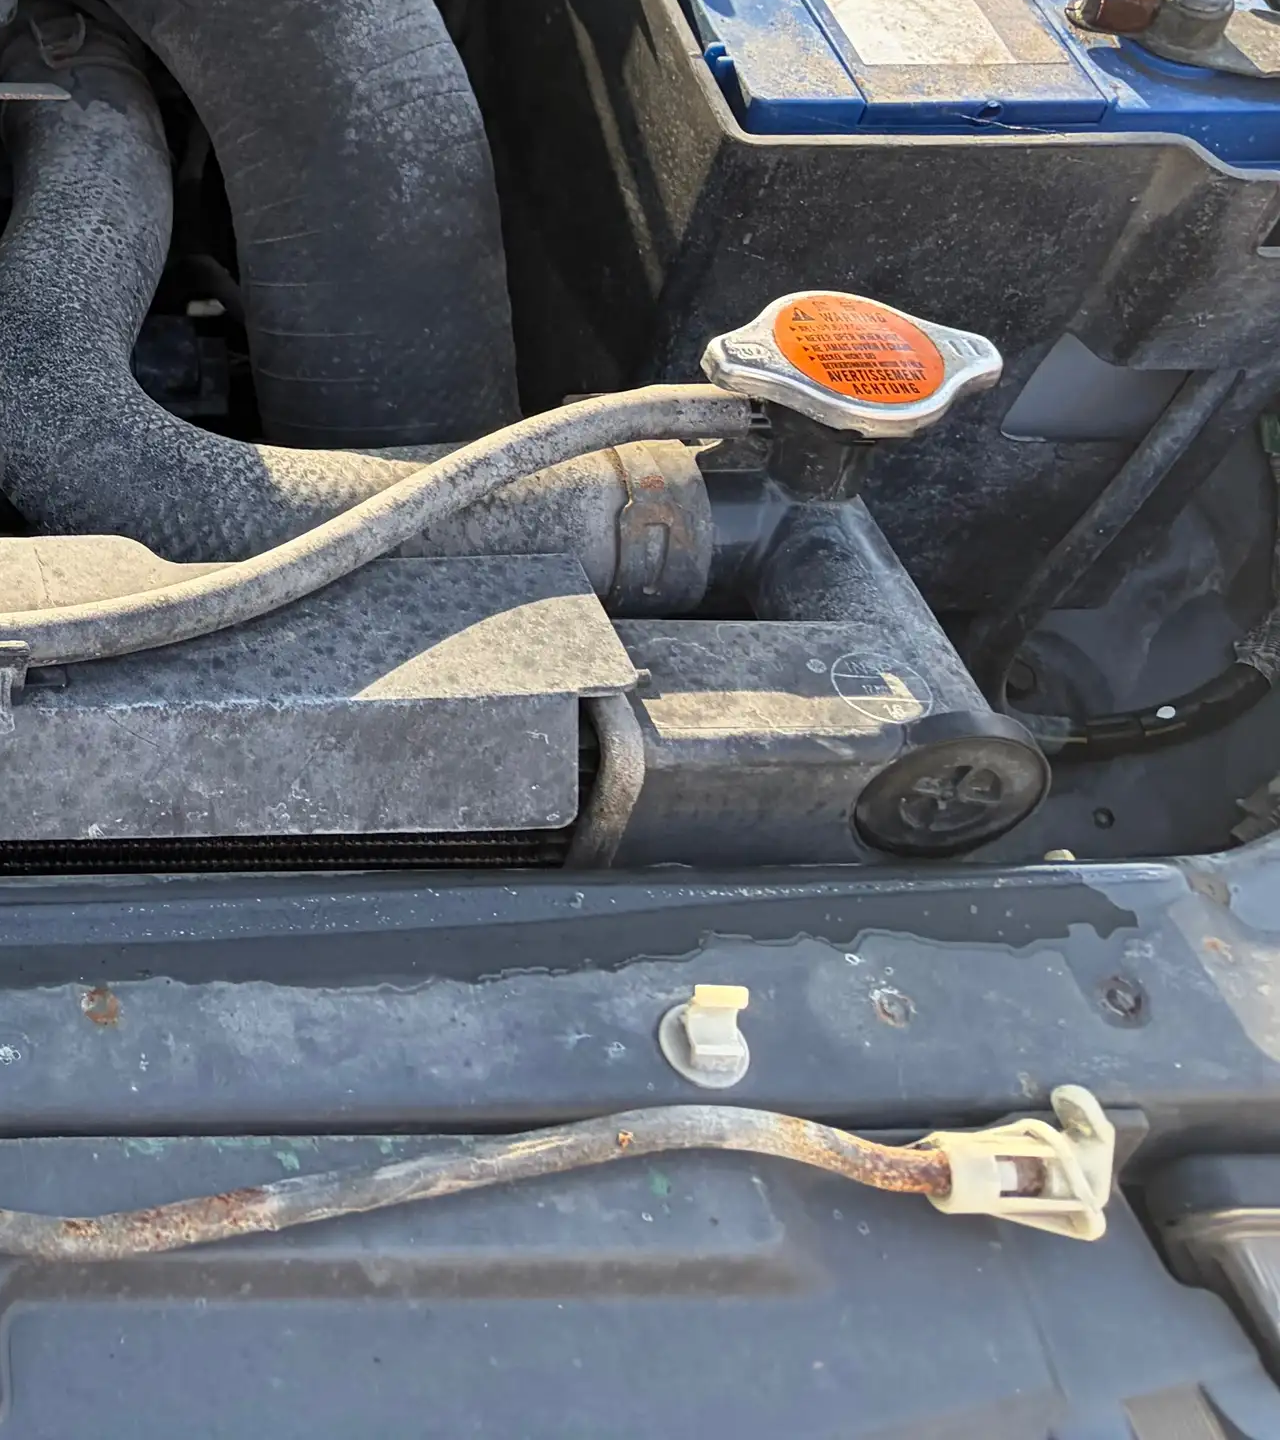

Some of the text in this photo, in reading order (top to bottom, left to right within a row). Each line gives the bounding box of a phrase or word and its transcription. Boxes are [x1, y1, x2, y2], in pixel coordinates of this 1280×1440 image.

[819, 312, 888, 323] WARNING
[827, 369, 928, 383] AVERTISSEMENT
[853, 382, 921, 396] ACHTUNG
